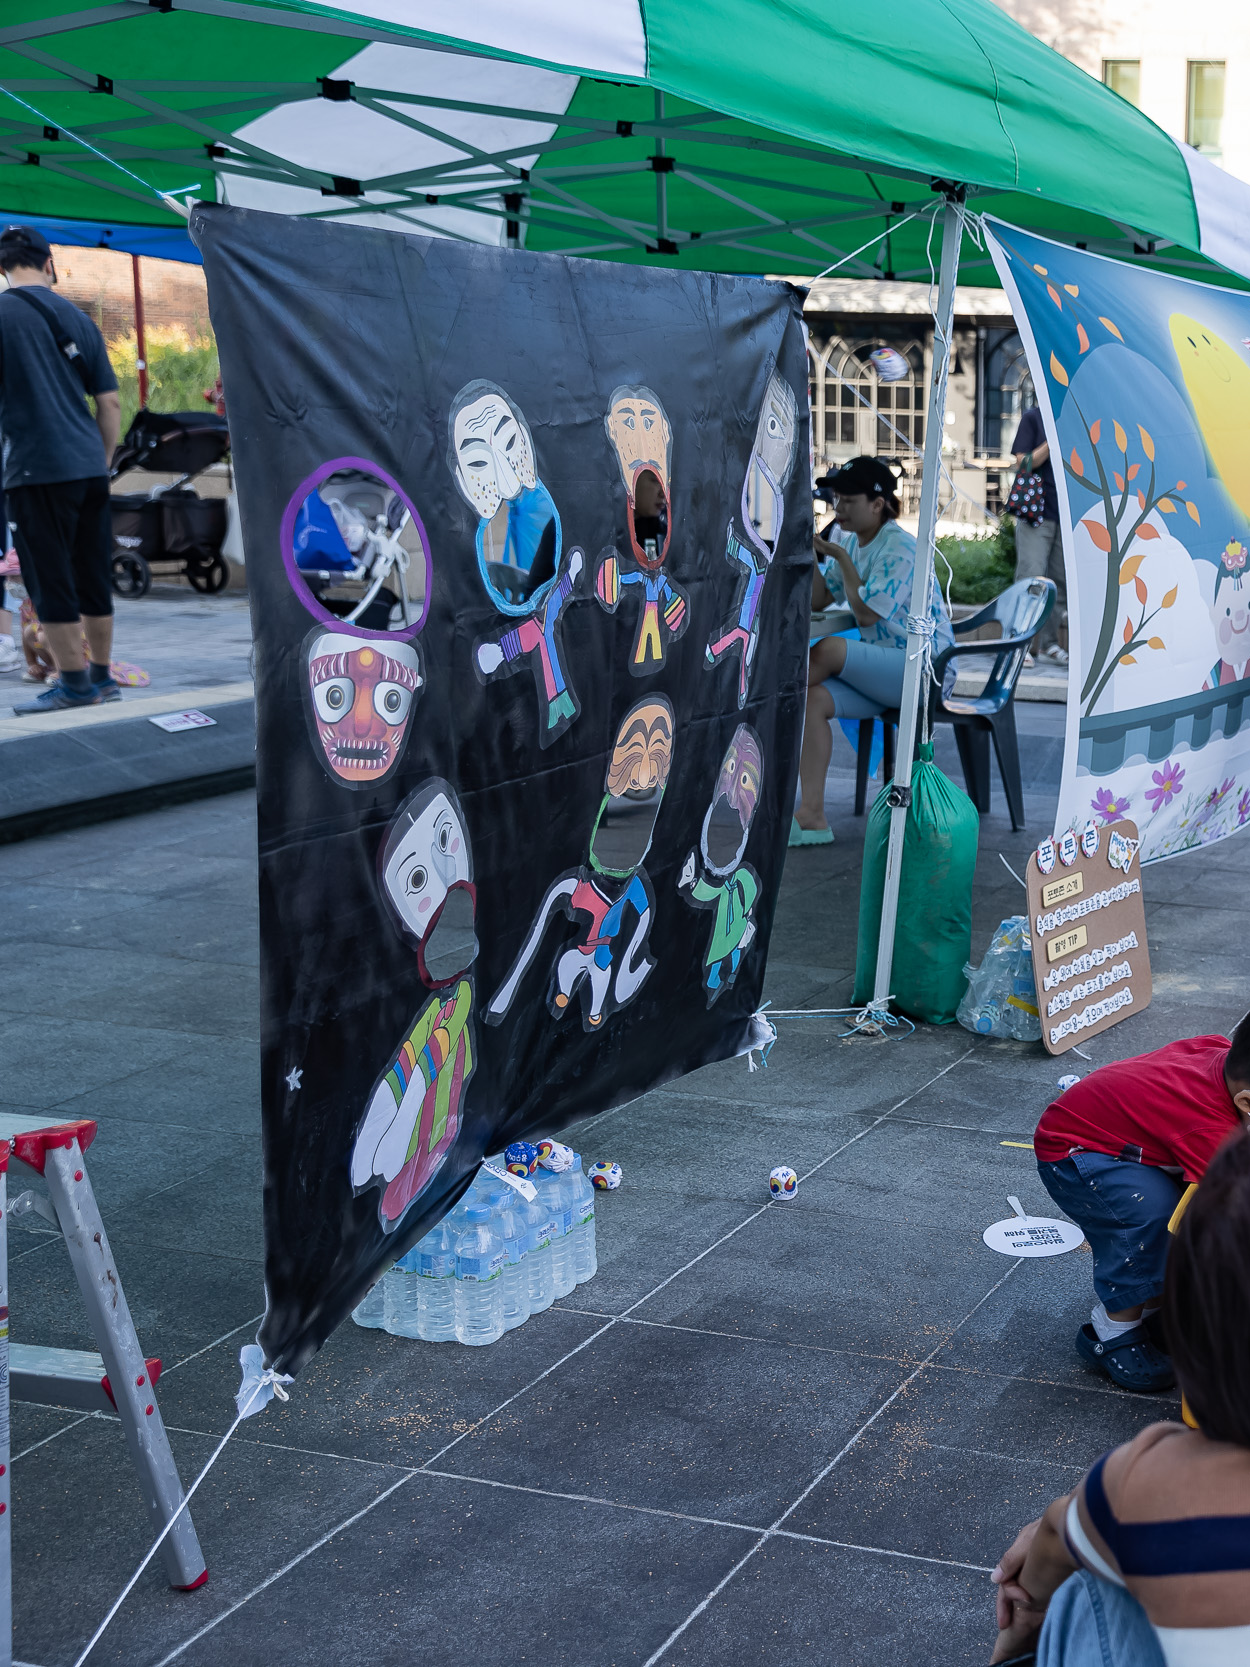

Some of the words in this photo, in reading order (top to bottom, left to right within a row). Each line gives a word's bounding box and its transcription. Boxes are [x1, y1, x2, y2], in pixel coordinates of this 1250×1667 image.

[1047, 884, 1065, 901] 포토존
[1066, 879, 1078, 893] 소개
[1068, 934, 1078, 946] TIP
